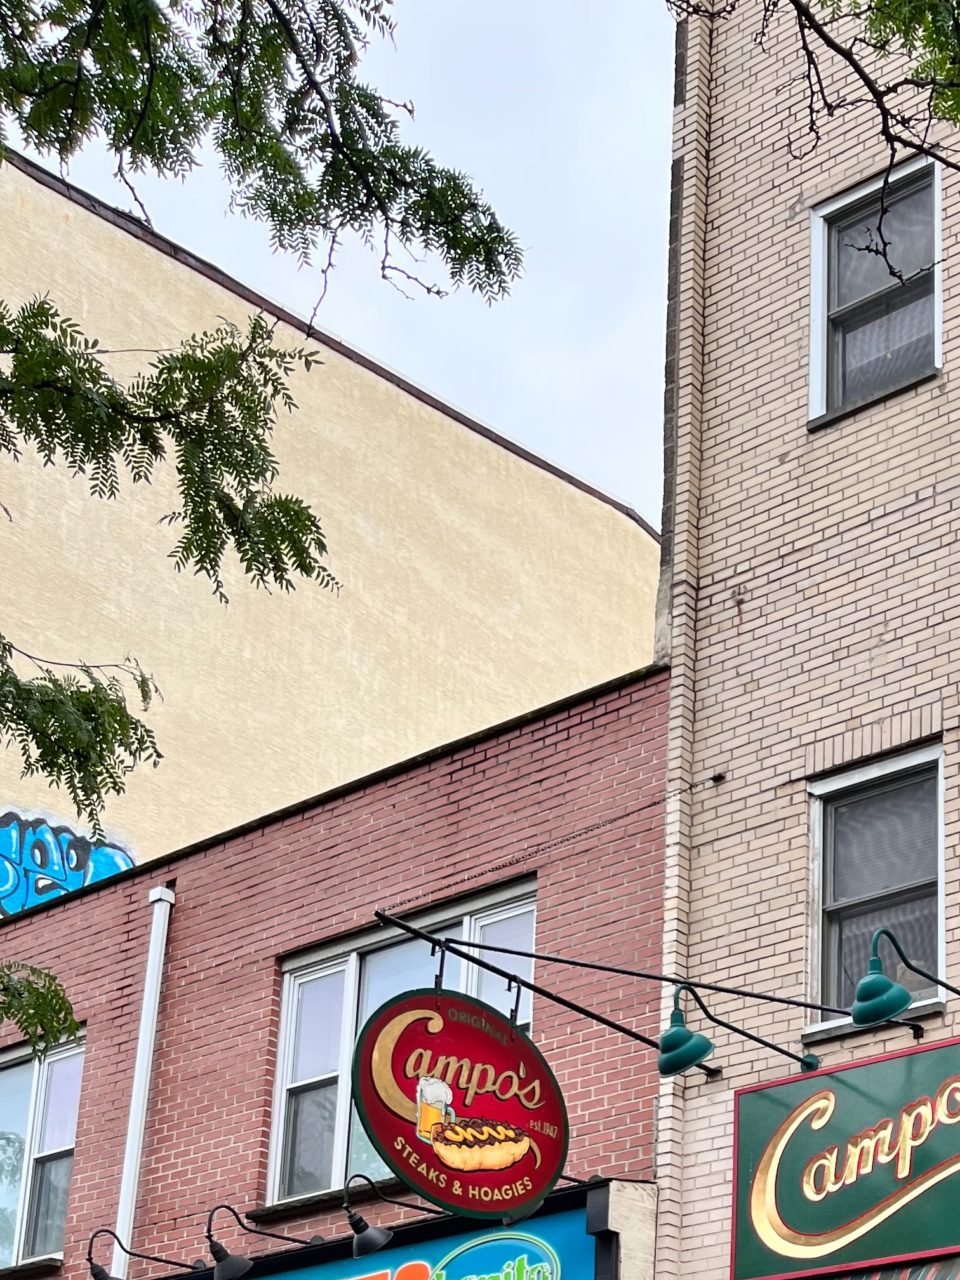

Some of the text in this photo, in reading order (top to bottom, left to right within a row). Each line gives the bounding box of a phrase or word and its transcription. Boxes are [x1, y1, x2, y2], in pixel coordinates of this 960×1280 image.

[371, 1009, 547, 1125] Campo's
[393, 1136, 533, 1201] STEAKS & HOAGIES
